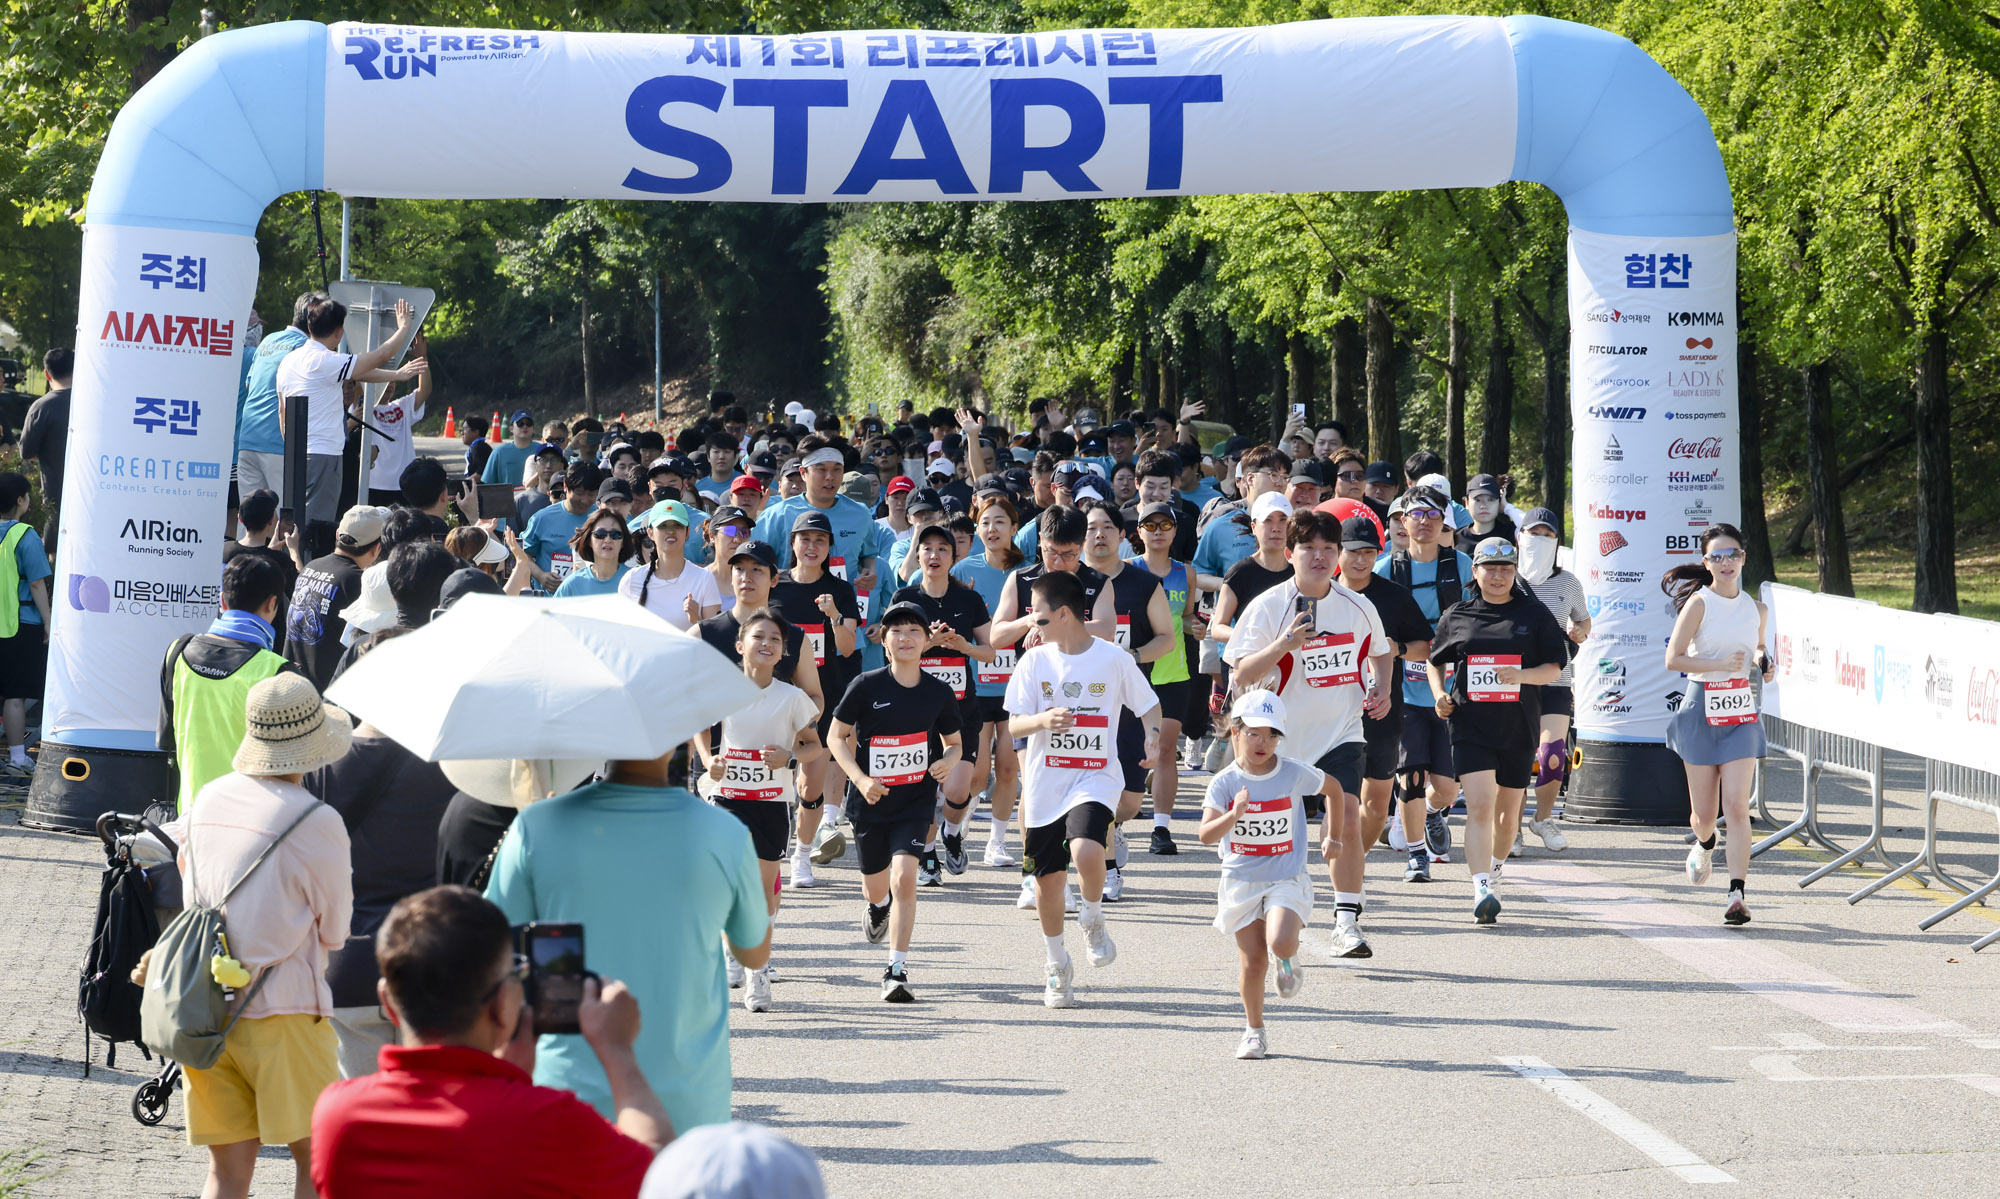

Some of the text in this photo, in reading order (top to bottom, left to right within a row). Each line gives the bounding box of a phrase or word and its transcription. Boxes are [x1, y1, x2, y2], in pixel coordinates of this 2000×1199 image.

[345, 27, 386, 35] THE
[685, 32, 1158, 69] 제1회 리프레시런
[621, 75, 1224, 195] START
[139, 253, 207, 292] 주최
[1624, 253, 1693, 289] 협찬
[1587, 313, 1608, 323] SANG
[100, 310, 234, 356] 시사저널
[1589, 345, 1648, 356] FITCULATOR
[1668, 371, 1712, 387] LADY
[1673, 389, 1694, 397] BEAUTY
[133, 396, 201, 436] 주관
[1675, 411, 1726, 420] toss payments
[1668, 436, 1724, 459] Coca-Cola
[100, 454, 217, 481] CREATE MORE
[1667, 471, 1690, 482] KH
[99, 481, 218, 499] Contents Creator Group
[1589, 500, 1646, 522] Kabaya
[128, 544, 194, 559] Running Society
[114, 579, 220, 605] 마음인베스트먼
[115, 601, 220, 619] ACCELERAT
[1307, 650, 1352, 672] 5547
[929, 671, 962, 685] 723
[1088, 683, 1106, 693] CCS
[1593, 704, 1632, 713] ONYU DAY
[1710, 694, 1751, 711] 5692
[1050, 733, 1103, 751] 5504
[875, 749, 924, 770] 5736
[1089, 760, 1102, 768] km
[726, 765, 776, 783] 5551
[1234, 817, 1289, 837] 5532
[1277, 845, 1289, 853] km
